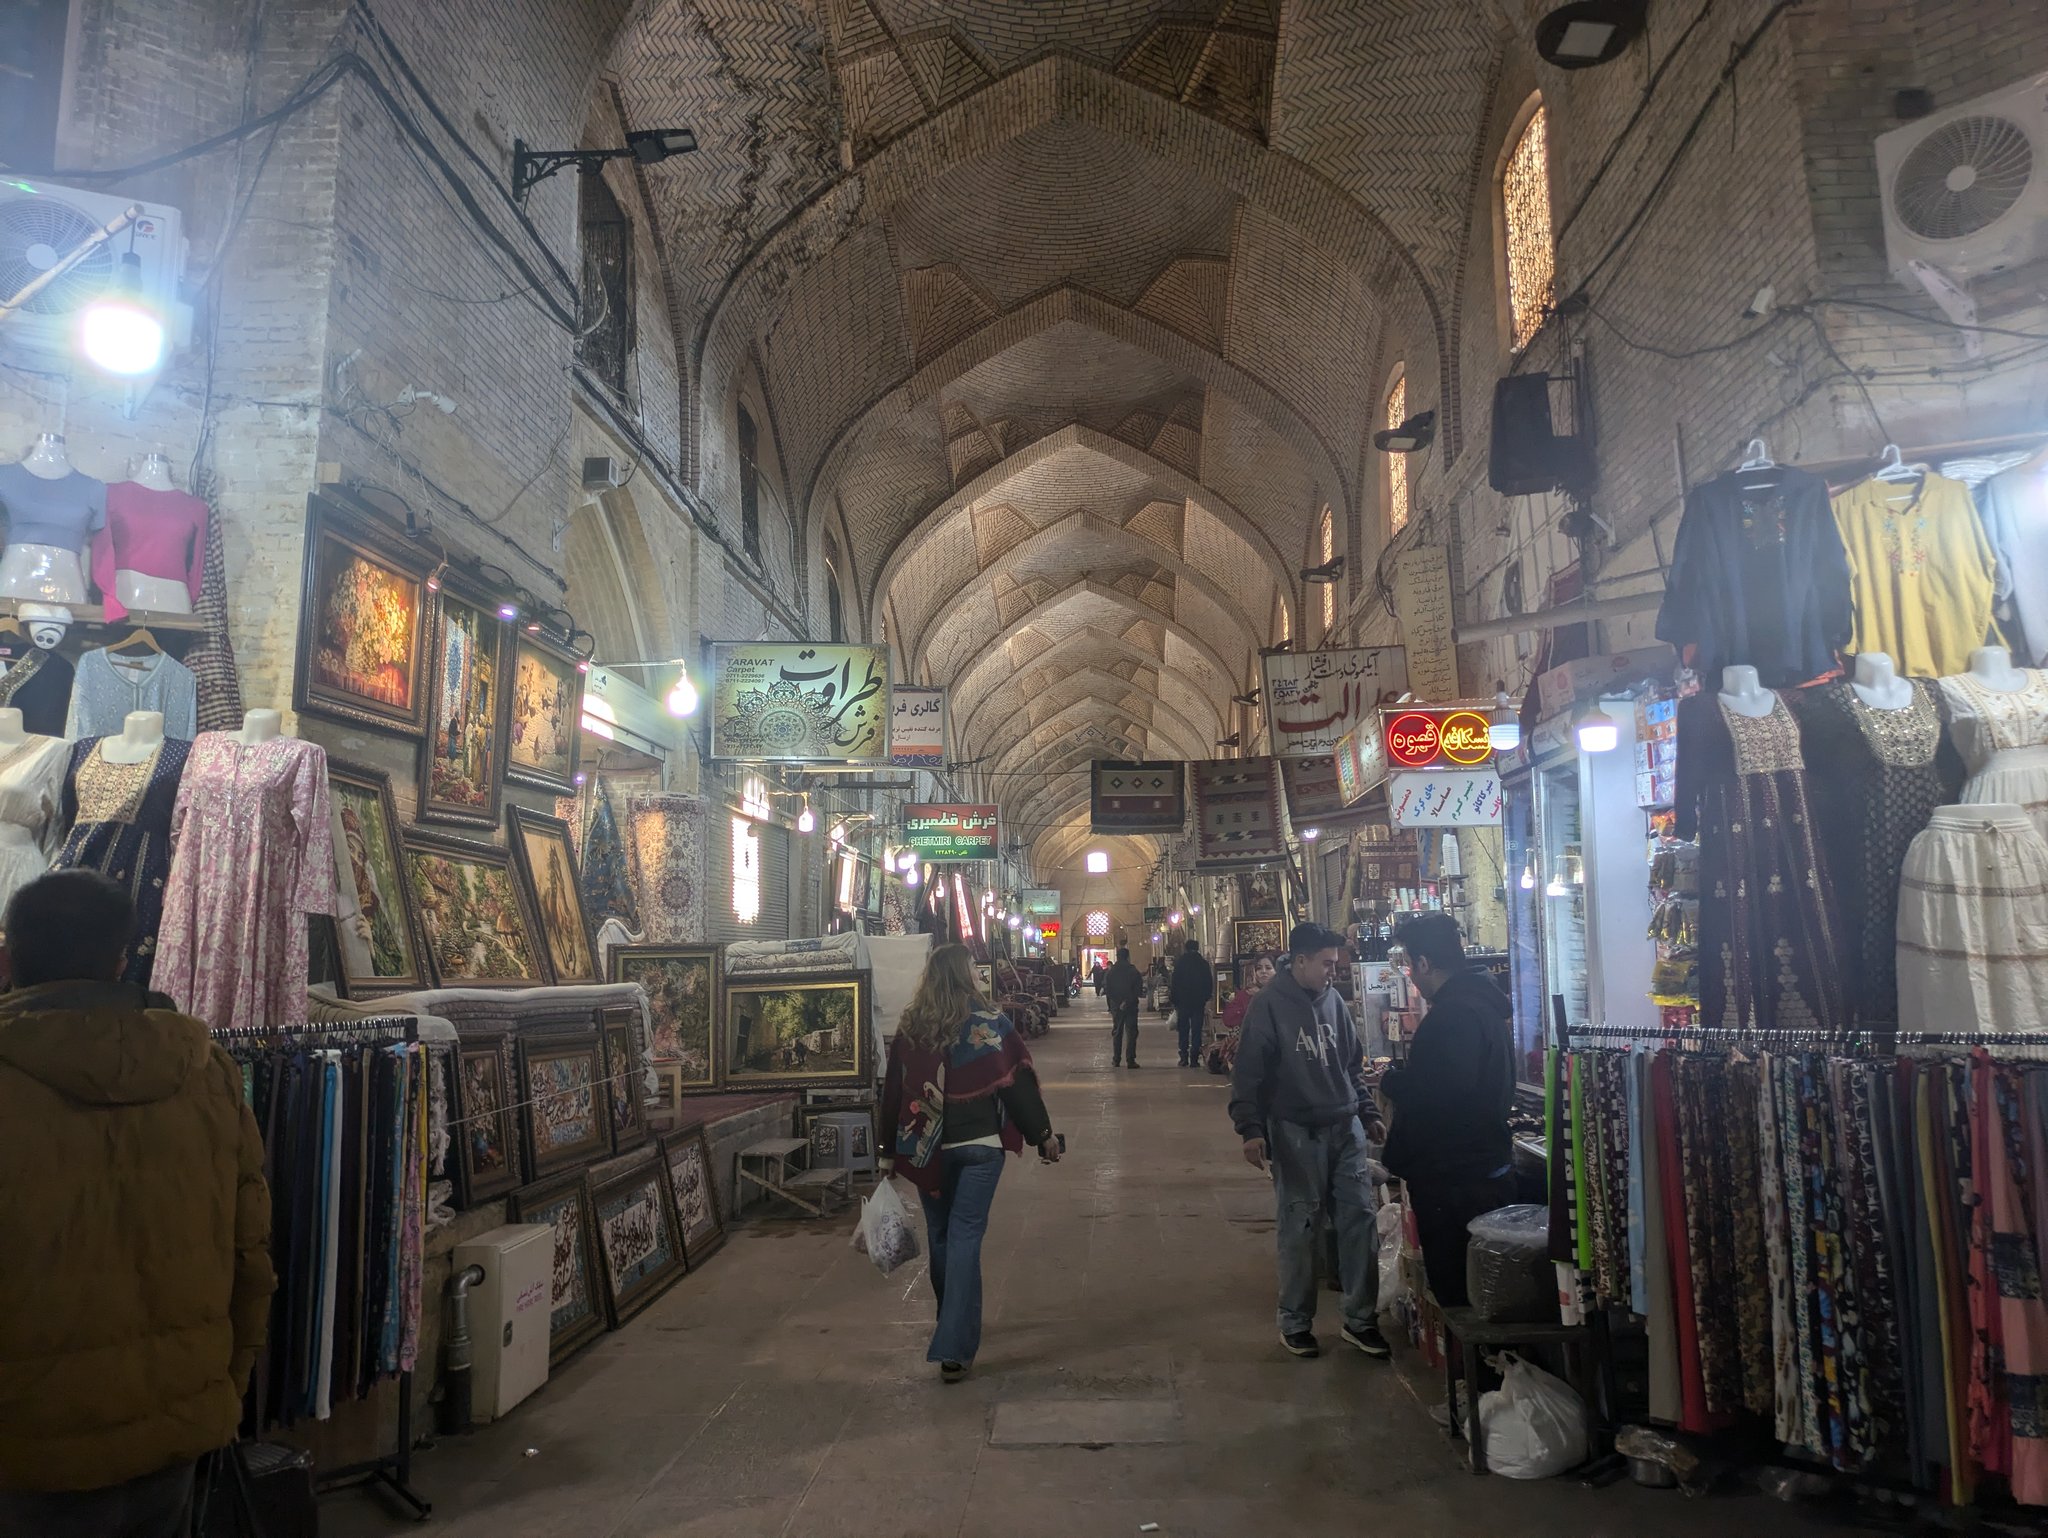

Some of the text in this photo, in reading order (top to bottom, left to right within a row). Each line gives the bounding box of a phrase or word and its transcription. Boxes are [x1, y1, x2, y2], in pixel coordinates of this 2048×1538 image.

[780, 649, 883, 731] طراوت
[893, 697, 940, 716] گالری فر
[834, 704, 881, 753] فرش
[1393, 723, 1490, 755] نسکافه قهوه
[907, 811, 997, 830] فرش قطمیری
[909, 836, 992, 846] GHETMIRI CARPET
